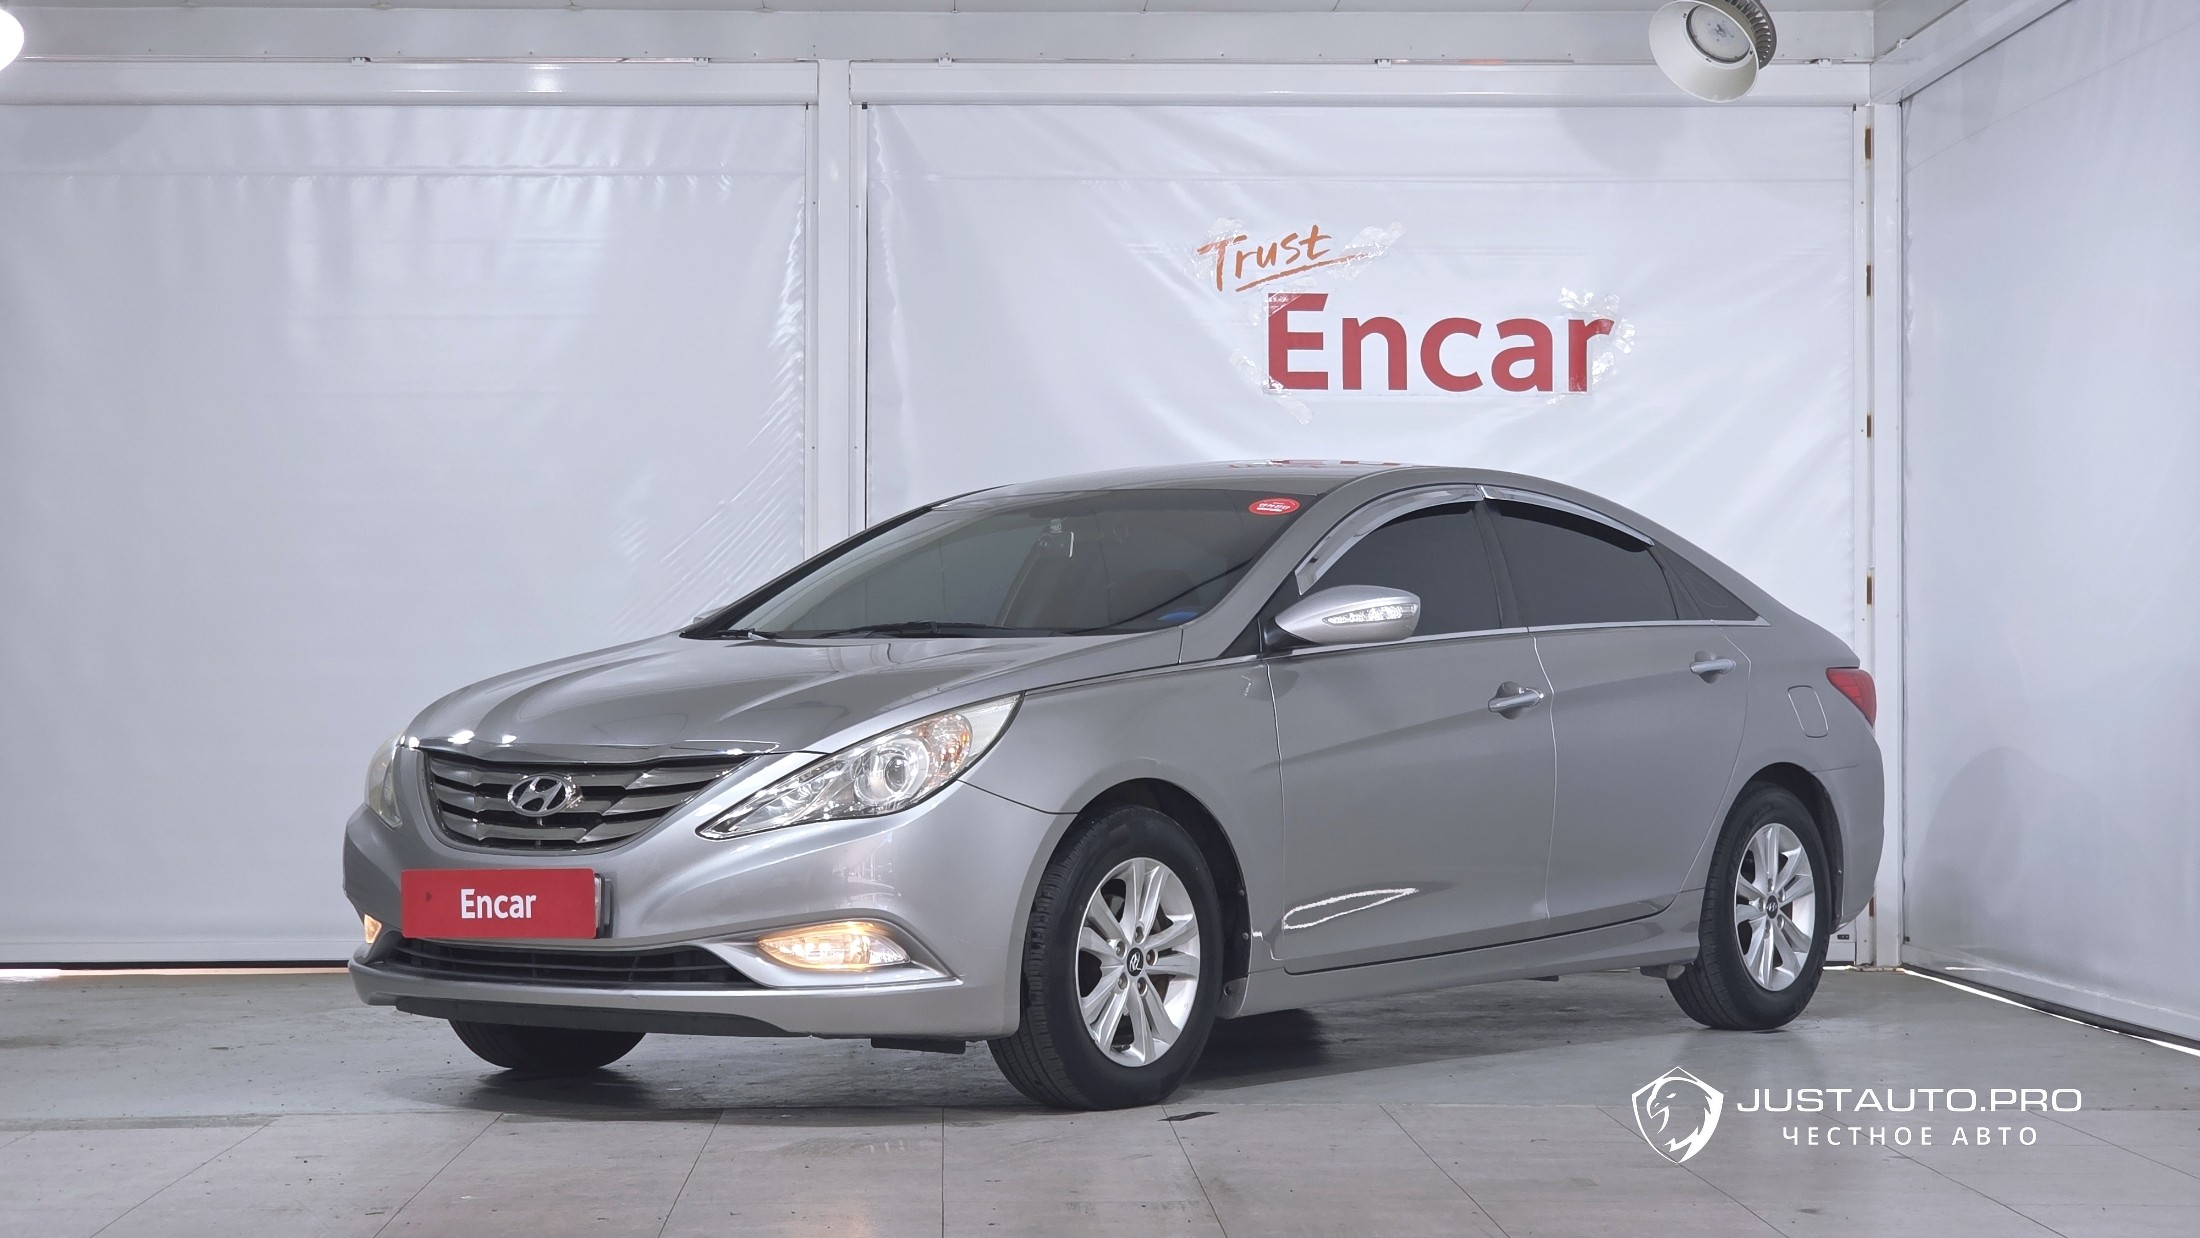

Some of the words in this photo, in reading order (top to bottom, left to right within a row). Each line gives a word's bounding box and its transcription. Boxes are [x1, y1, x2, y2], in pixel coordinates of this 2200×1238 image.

[1197, 224, 1333, 292] Trust
[1268, 293, 1614, 391] Encar
[460, 888, 537, 919] Encar
